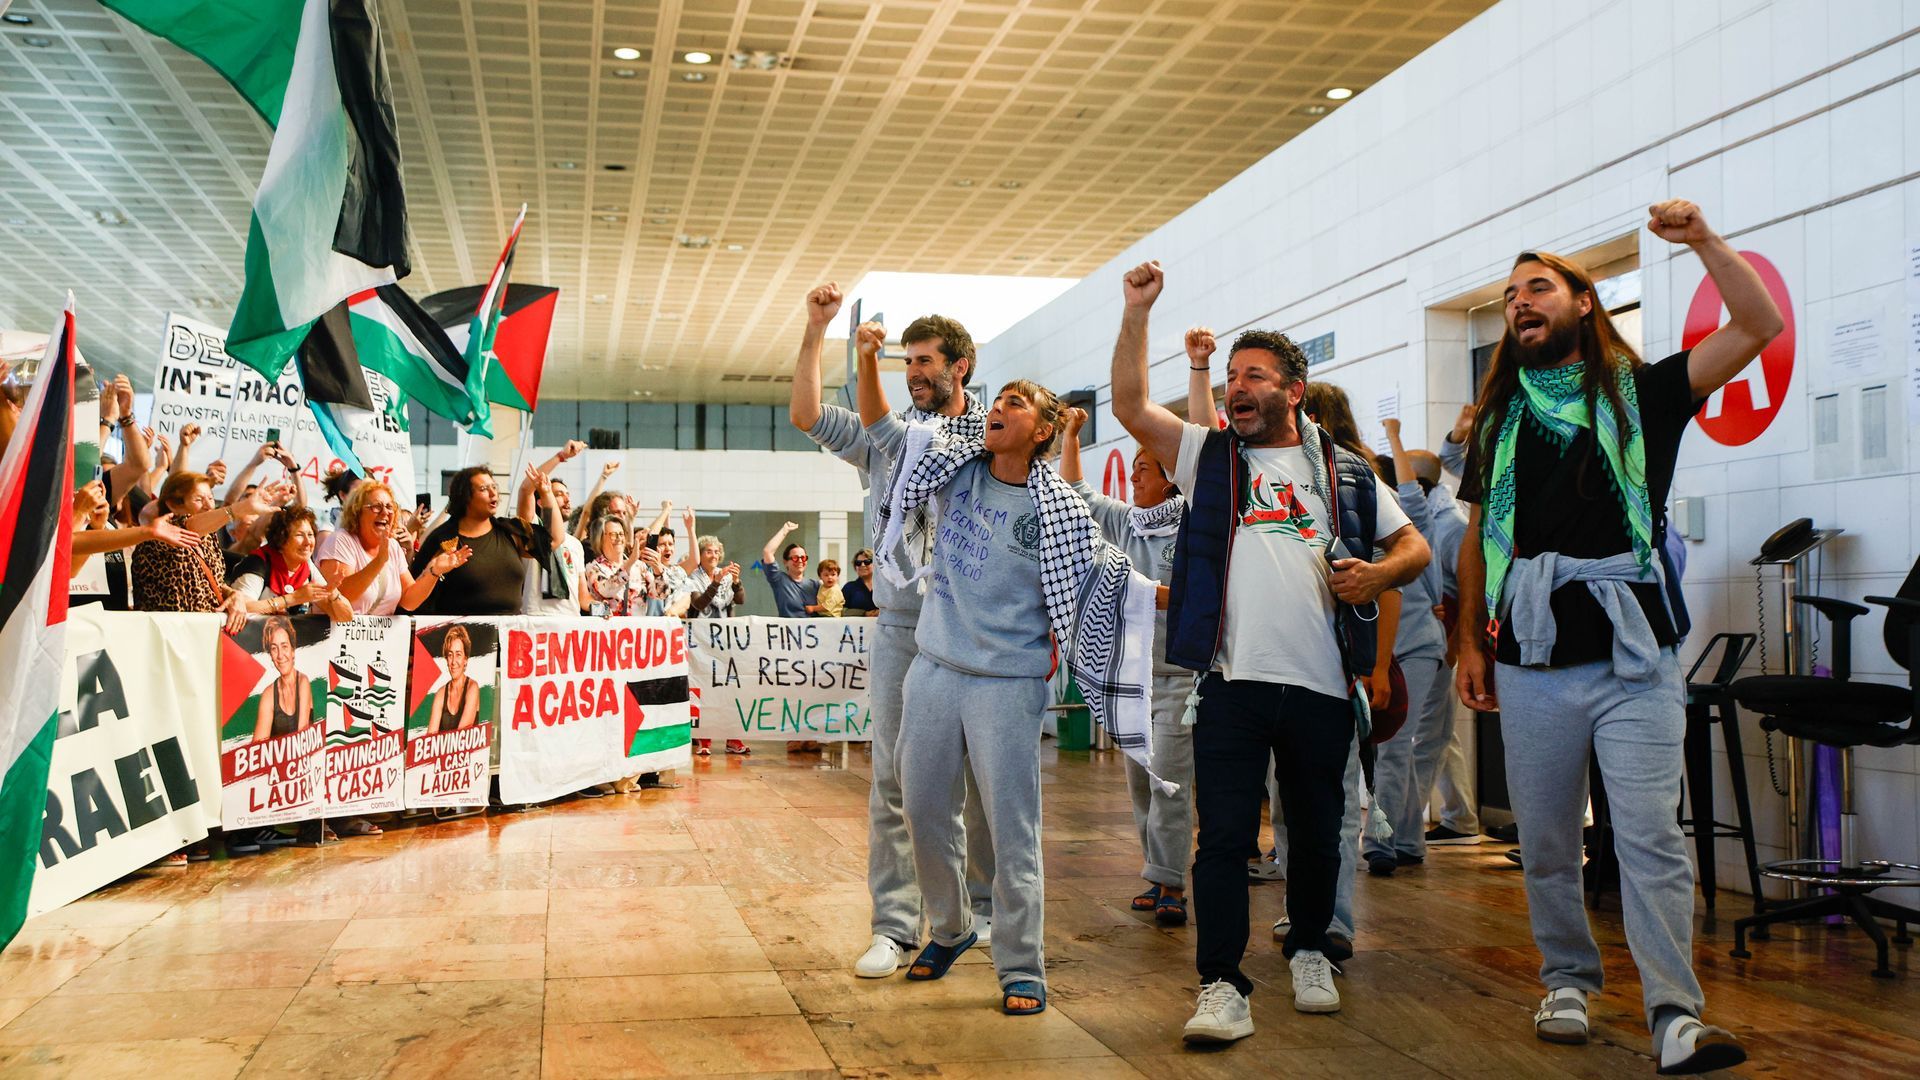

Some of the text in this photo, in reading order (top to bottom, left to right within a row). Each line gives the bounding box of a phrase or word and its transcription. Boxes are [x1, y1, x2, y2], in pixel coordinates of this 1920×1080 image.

[231, 427, 264, 443] ENRE
[345, 628, 385, 641] FLOTILLA
[368, 617, 393, 629] SUMUD
[709, 622, 751, 651] RIU
[766, 623, 819, 651] FINS
[838, 624, 868, 653] AL
[712, 656, 868, 690] LA RESISTÈ
[234, 723, 324, 778] BENVINGUDA
[326, 733, 401, 778] ENVINGUDA
[413, 724, 487, 763] BENVINGUDA
[267, 765, 280, 785] A
[434, 751, 470, 774] A CASA
[249, 772, 315, 813] LAURA
[337, 767, 383, 802] CASA
[420, 768, 471, 796] LAURA
[38, 735, 201, 870] RAEL
